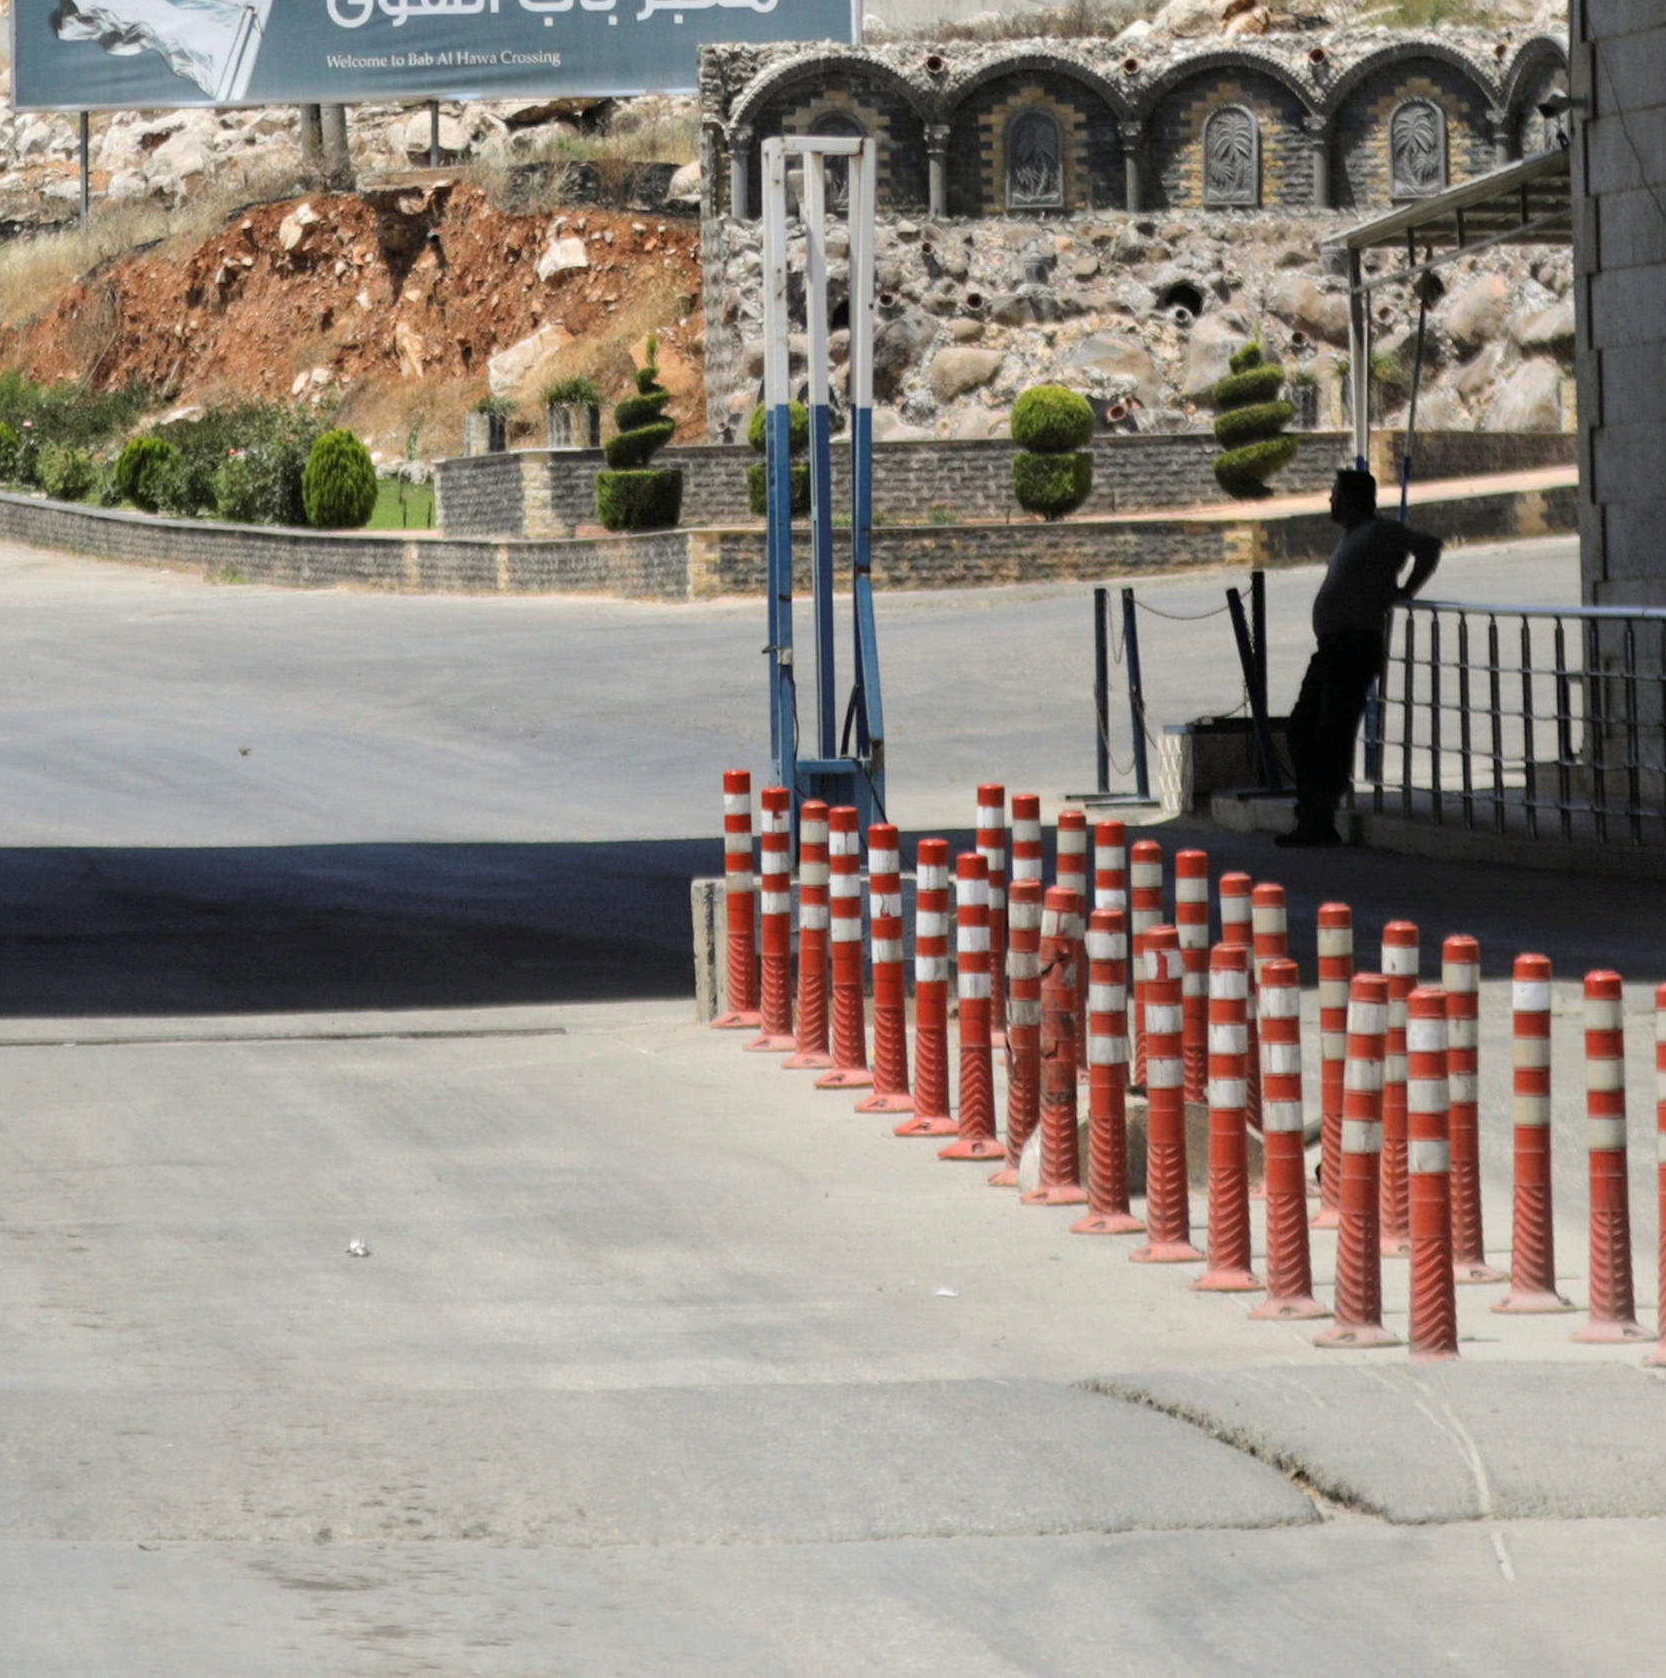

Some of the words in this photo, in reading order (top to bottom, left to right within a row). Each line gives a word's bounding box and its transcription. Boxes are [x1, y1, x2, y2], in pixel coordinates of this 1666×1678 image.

[326, 54, 388, 69] Welcome
[391, 55, 406, 68] to
[407, 52, 434, 68] Bab
[436, 51, 453, 66] Al
[456, 51, 497, 66] Hawa
[499, 49, 562, 68] Crossing
